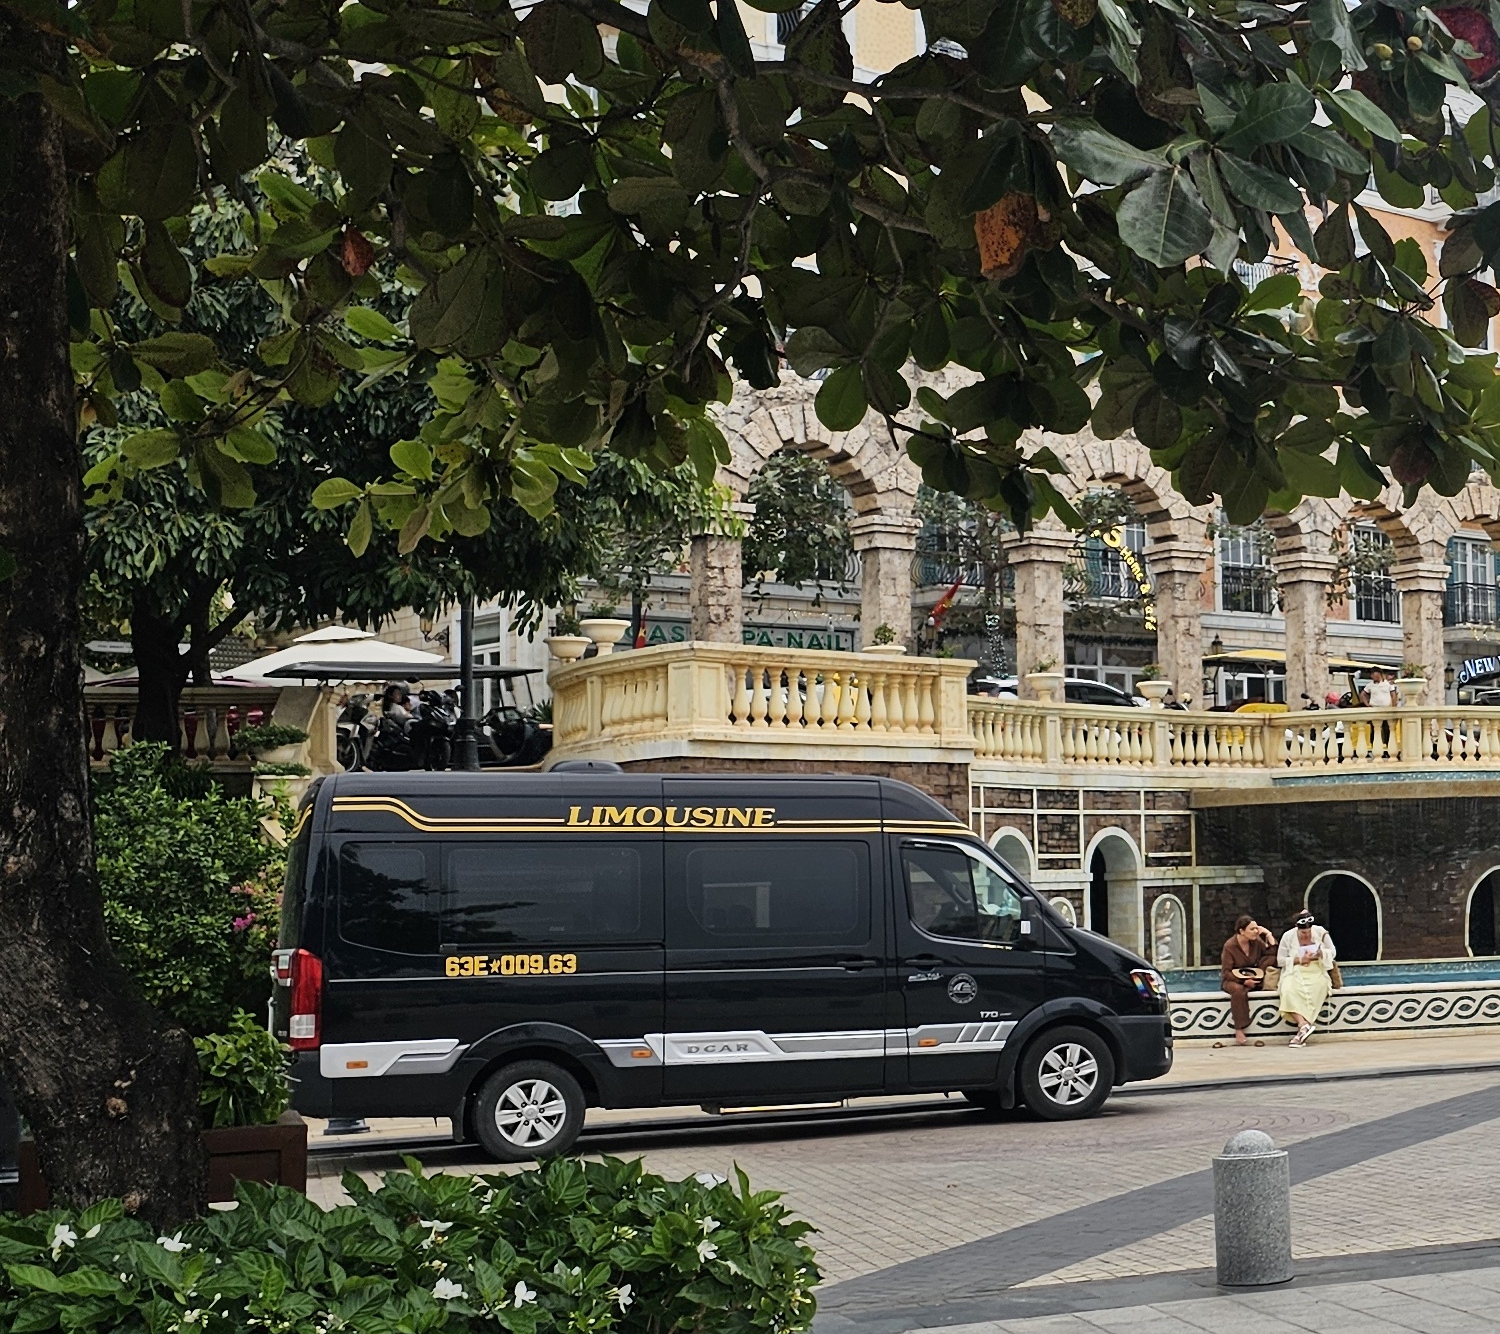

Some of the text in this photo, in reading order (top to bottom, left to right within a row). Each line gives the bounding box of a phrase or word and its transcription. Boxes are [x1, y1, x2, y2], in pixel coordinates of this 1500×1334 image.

[742, 629, 846, 651] PA-NAIL
[1459, 656, 1496, 684] NEW
[566, 806, 776, 827] LIMOUSINE
[687, 1043, 749, 1054] DCAR
